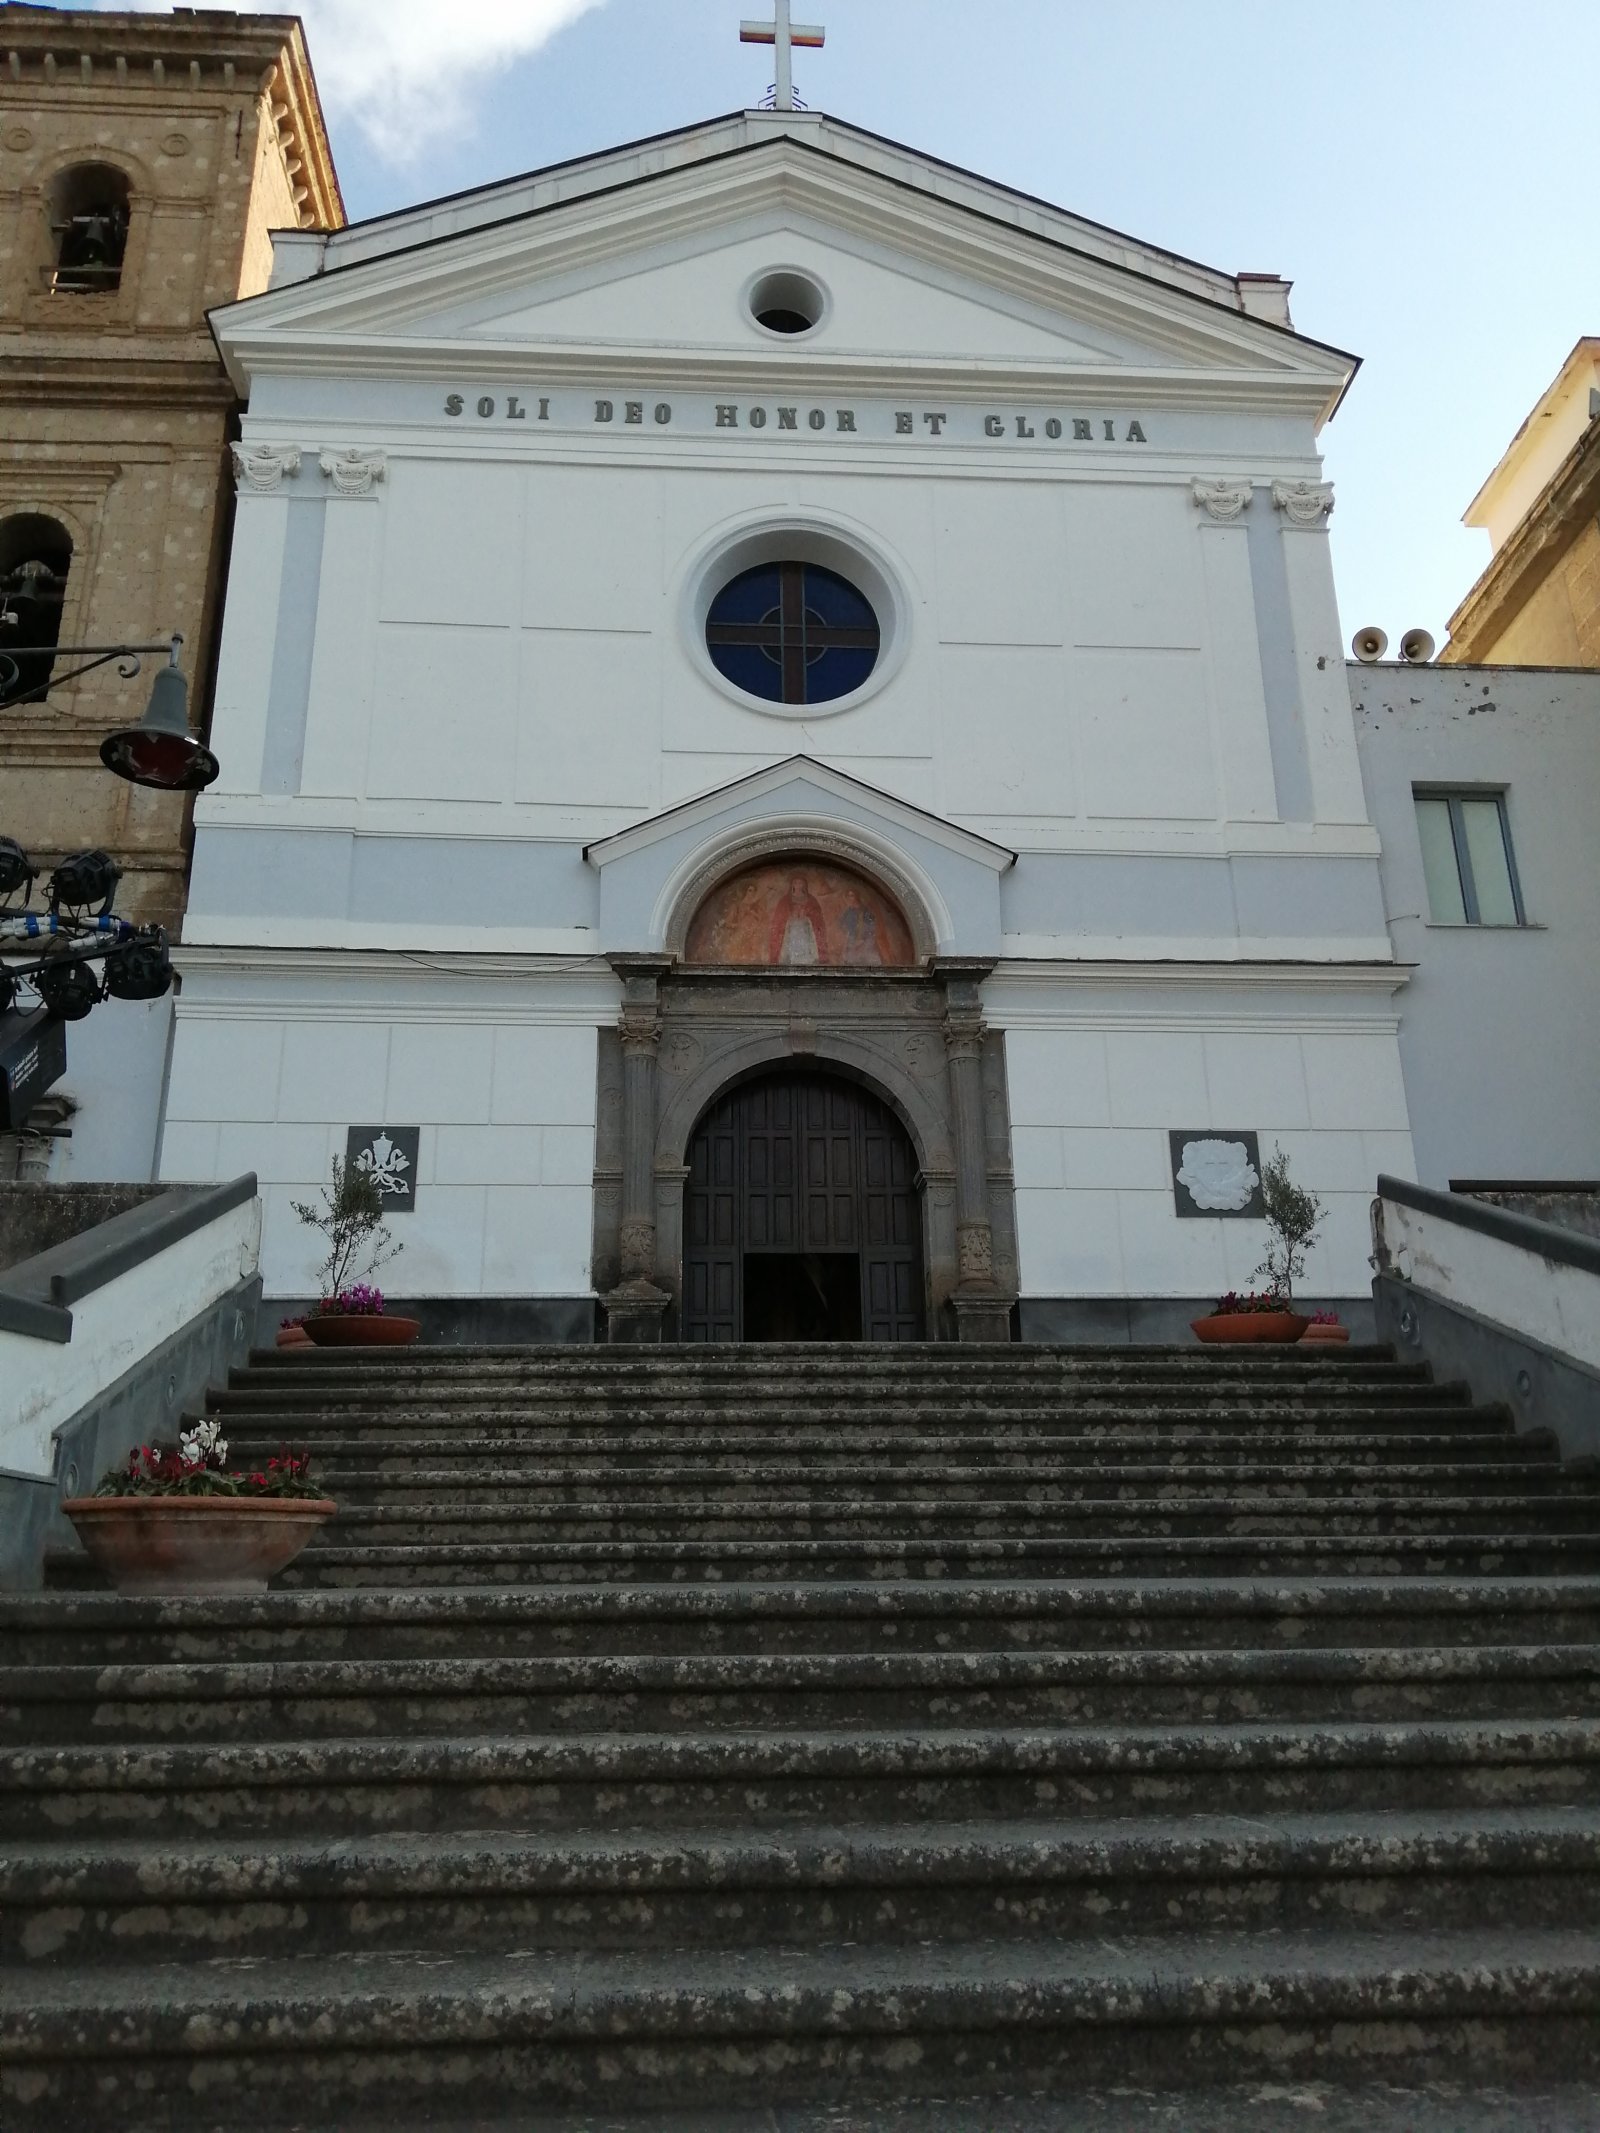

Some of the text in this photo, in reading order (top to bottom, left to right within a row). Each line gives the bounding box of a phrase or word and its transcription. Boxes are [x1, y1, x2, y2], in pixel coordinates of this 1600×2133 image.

[444, 394, 1148, 443] SOLI DEO HONOR ET GLORIA
